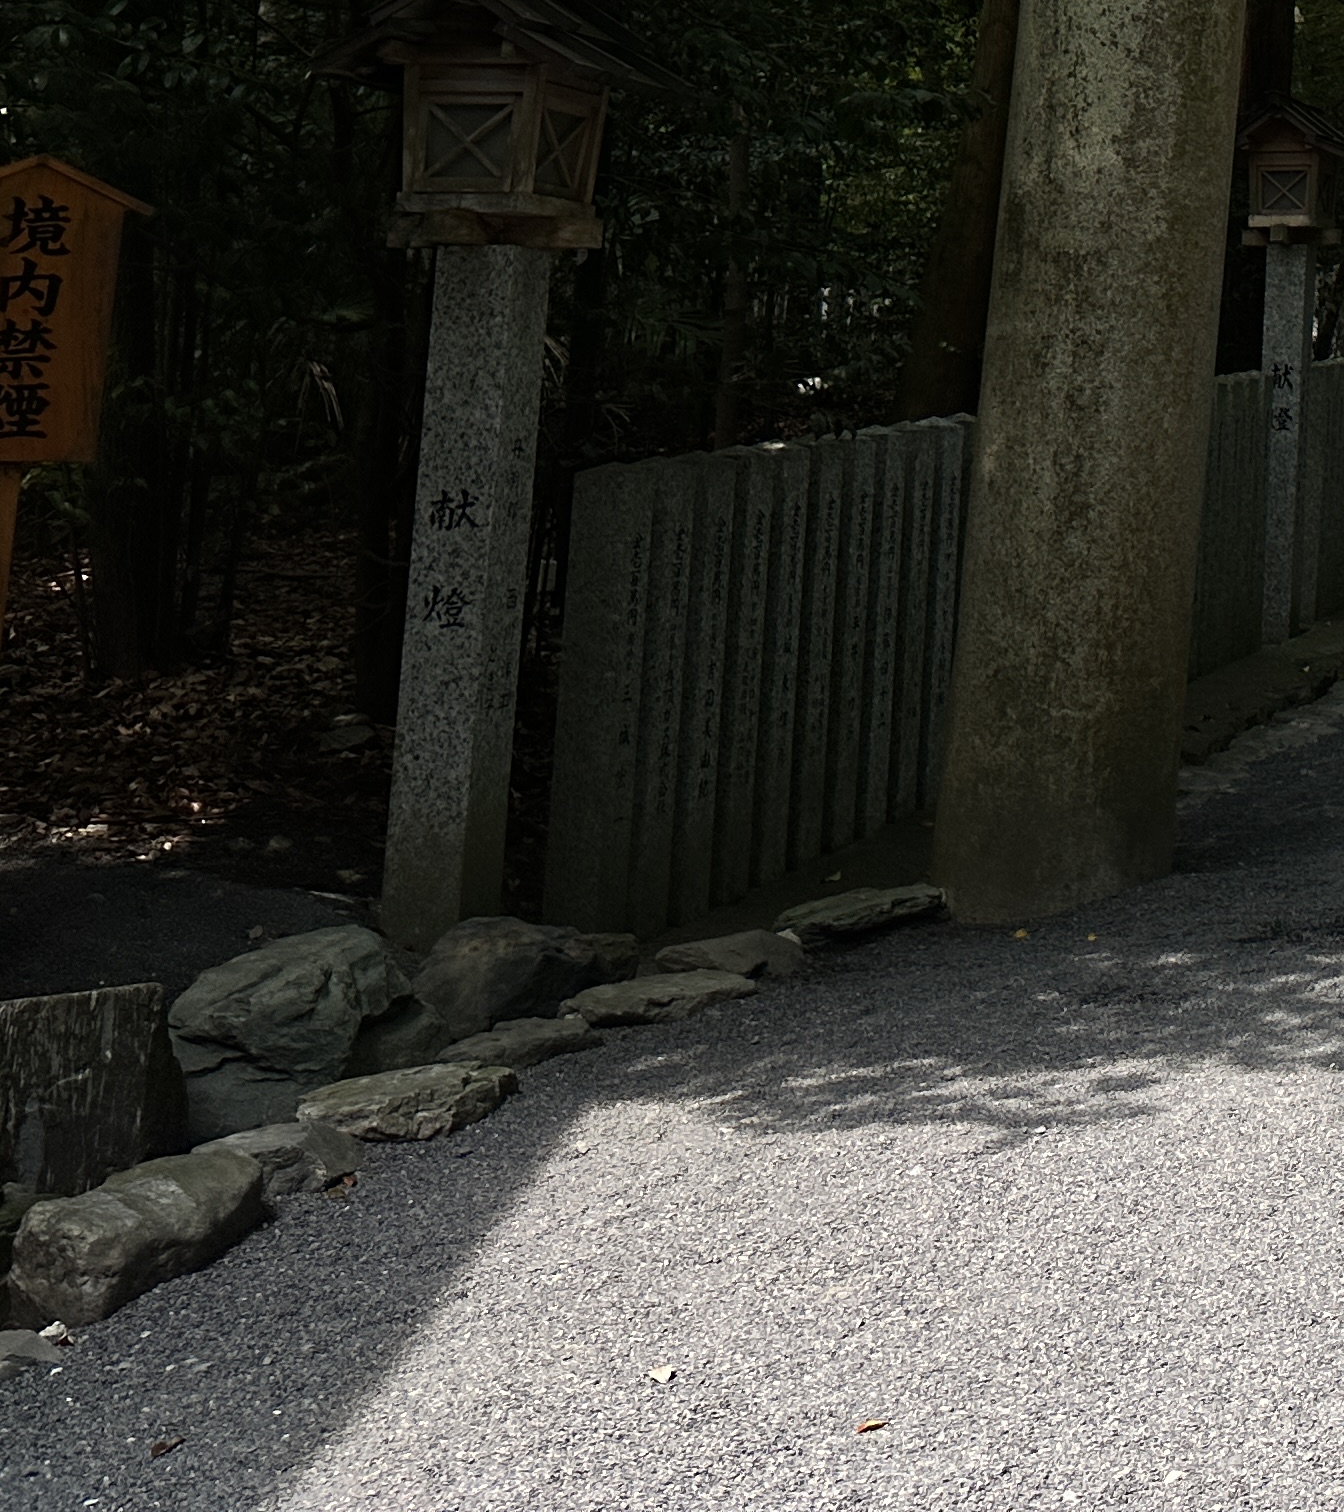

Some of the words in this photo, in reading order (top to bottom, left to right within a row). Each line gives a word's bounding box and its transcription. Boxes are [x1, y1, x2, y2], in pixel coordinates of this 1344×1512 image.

[0, 194, 71, 439] 境内禁煙
[424, 489, 479, 629] 献燈
